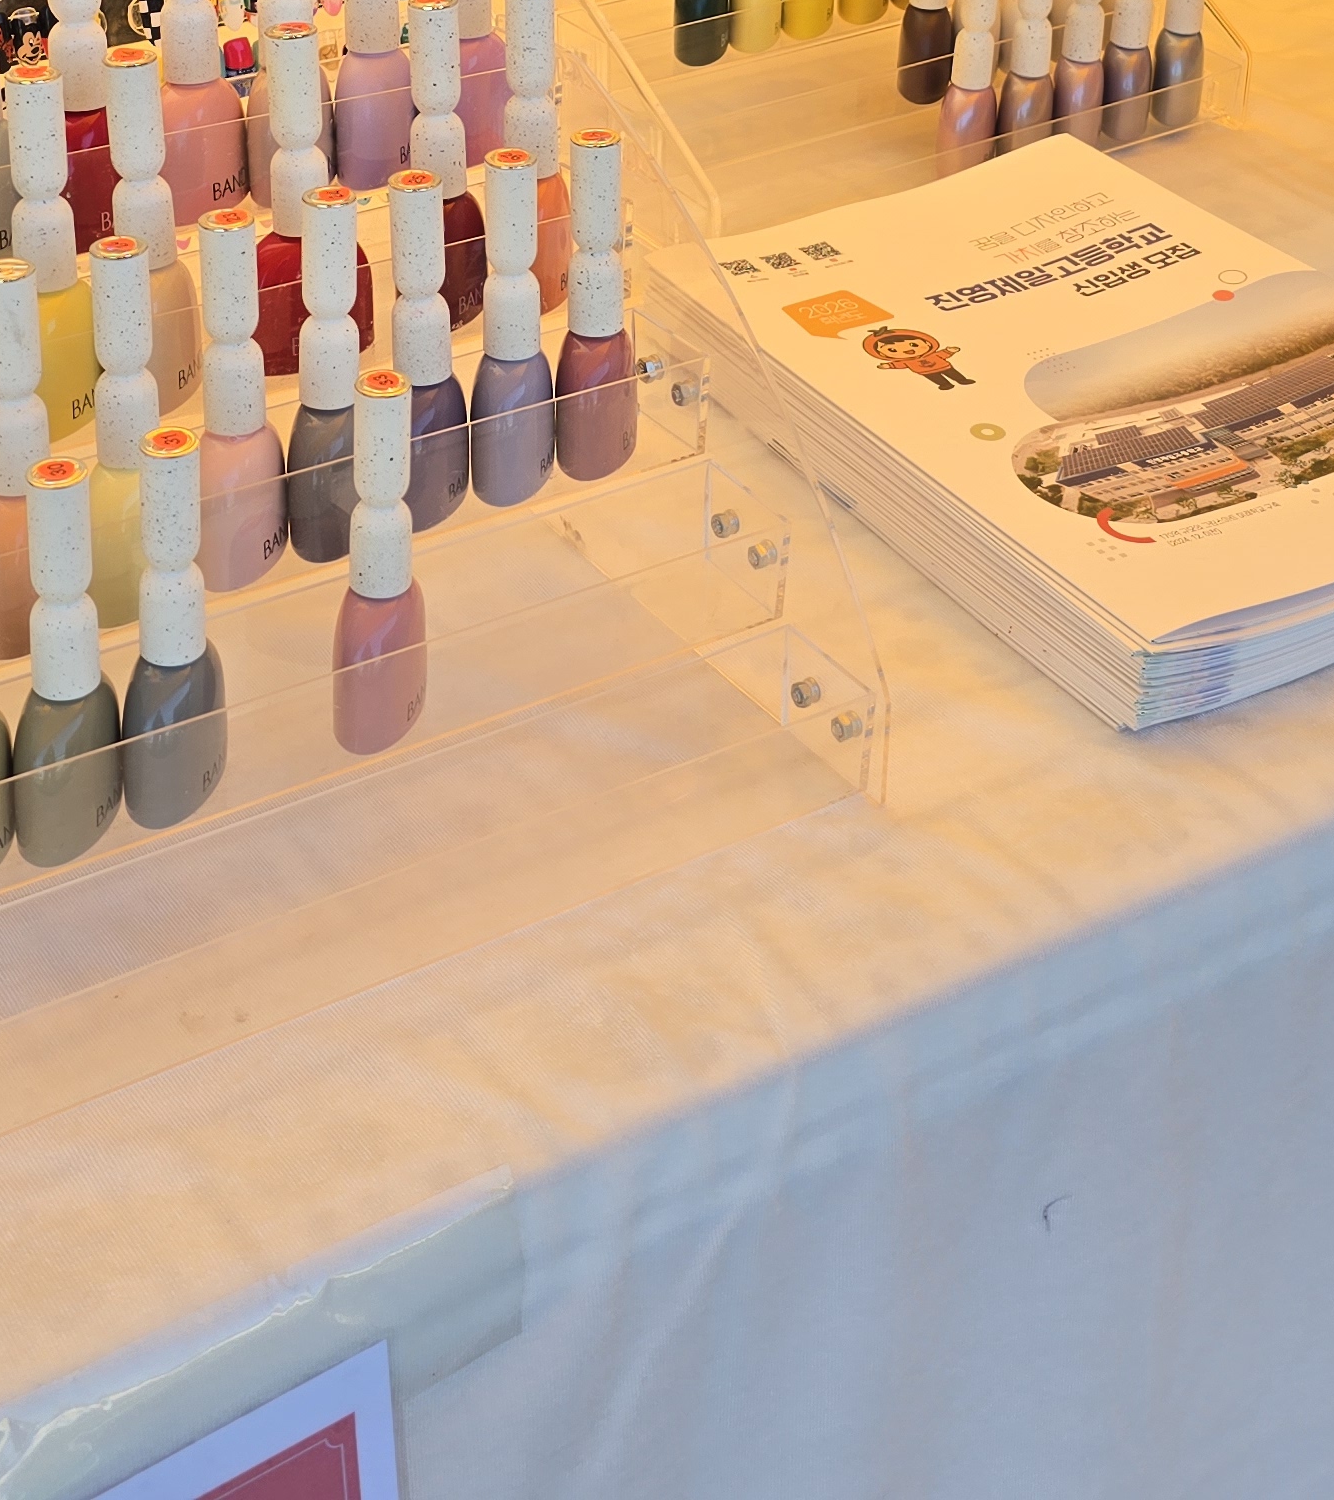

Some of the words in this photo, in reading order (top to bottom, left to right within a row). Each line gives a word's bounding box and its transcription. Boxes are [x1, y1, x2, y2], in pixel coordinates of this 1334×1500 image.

[1010, 192, 1114, 237] 디자인하고
[924, 222, 1173, 313] 진영제일고등학교
[1072, 261, 1151, 297] 신입생
[1142, 242, 1203, 270] 모집
[798, 298, 859, 319] 2026
